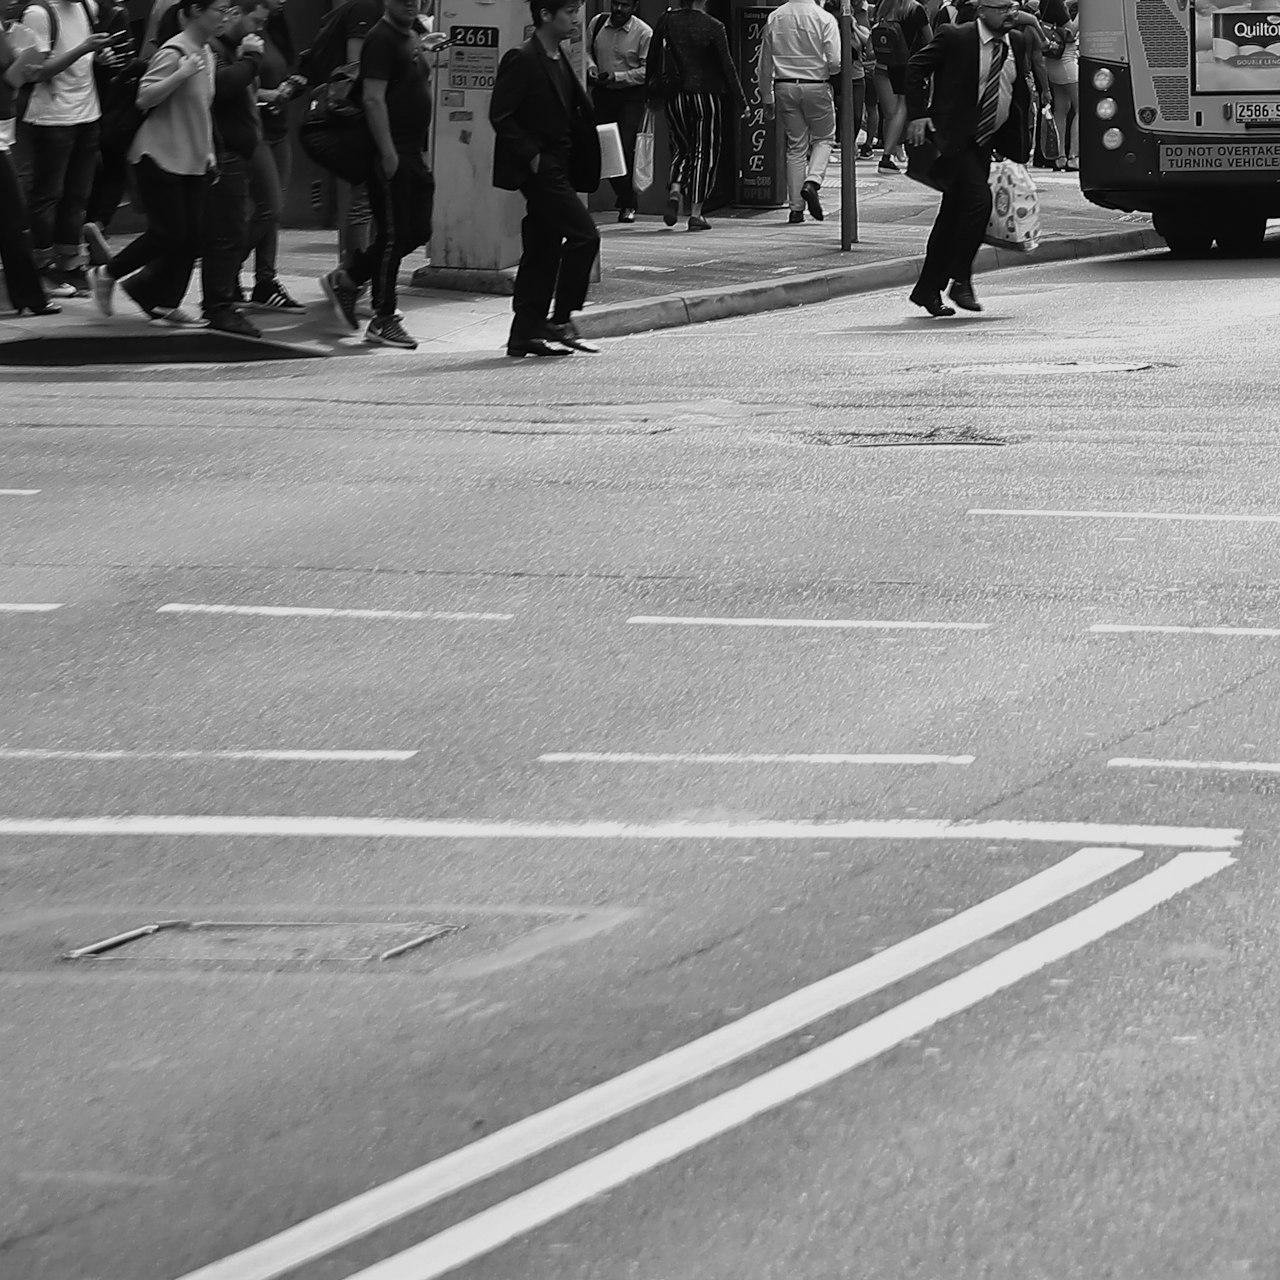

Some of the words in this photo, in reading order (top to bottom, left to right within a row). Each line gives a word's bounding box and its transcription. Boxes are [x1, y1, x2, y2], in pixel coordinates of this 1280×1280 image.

[456, 28, 493, 45] 2661
[452, 75, 467, 86] 131
[472, 75, 494, 87] 700
[1166, 147, 1182, 157] DO
[1188, 147, 1213, 157] NOT
[1217, 146, 1280, 156] OVERTAKE
[1168, 158, 1222, 169] TURNING
[1227, 157, 1279, 167] VEHICLE
